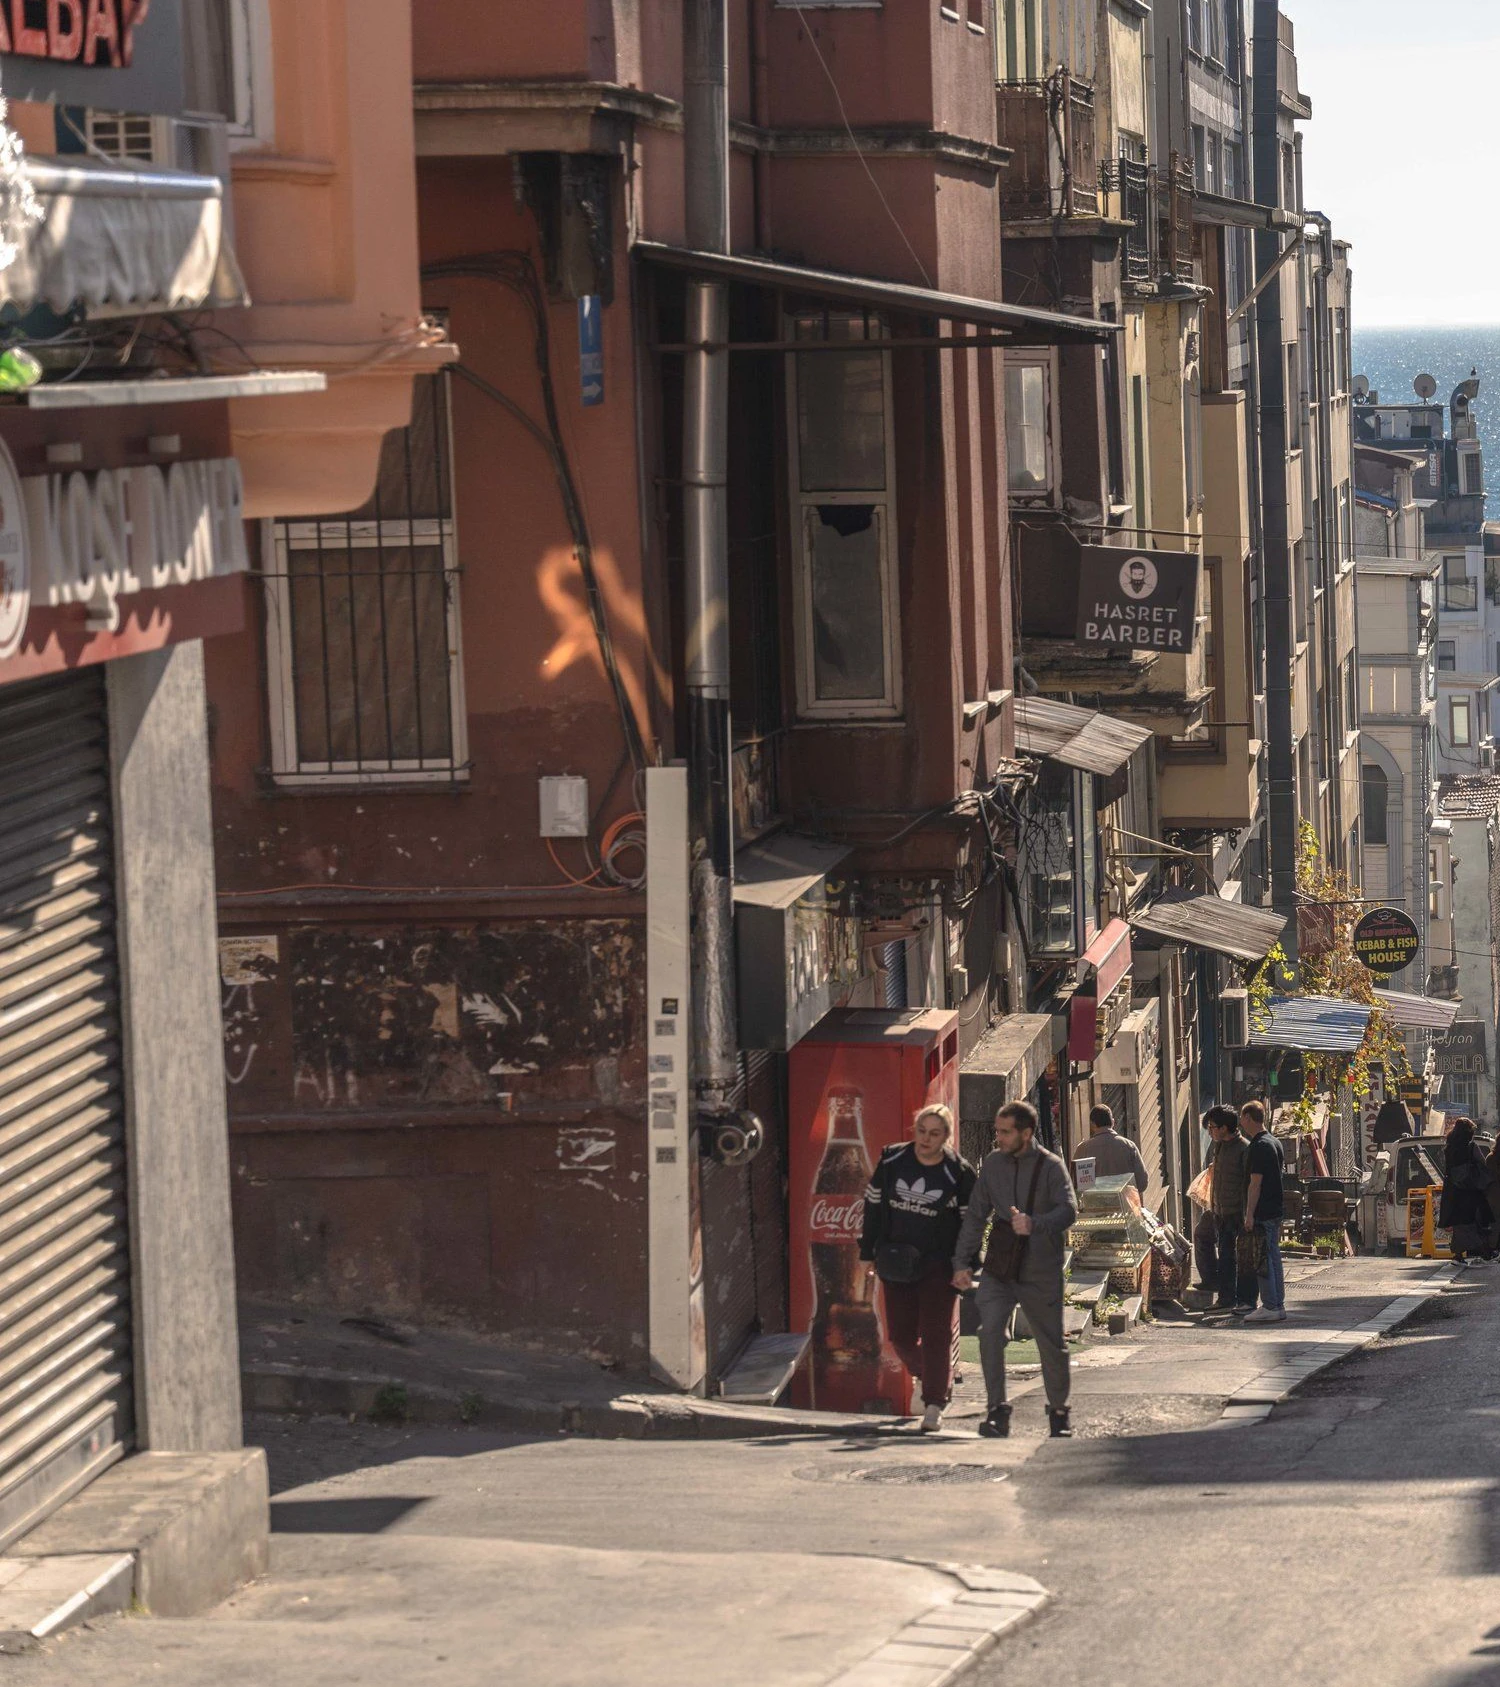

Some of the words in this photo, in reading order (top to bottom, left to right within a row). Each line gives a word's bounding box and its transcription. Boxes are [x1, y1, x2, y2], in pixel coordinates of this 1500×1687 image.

[1095, 602, 1178, 623] HASRET
[1085, 622, 1183, 647] BARBER
[1356, 939, 1386, 951] KEBAB
[1388, 938, 1395, 949] &
[1397, 936, 1418, 948] FISH
[1368, 950, 1407, 964] HOUSE
[810, 1199, 864, 1230] Coca-Co
